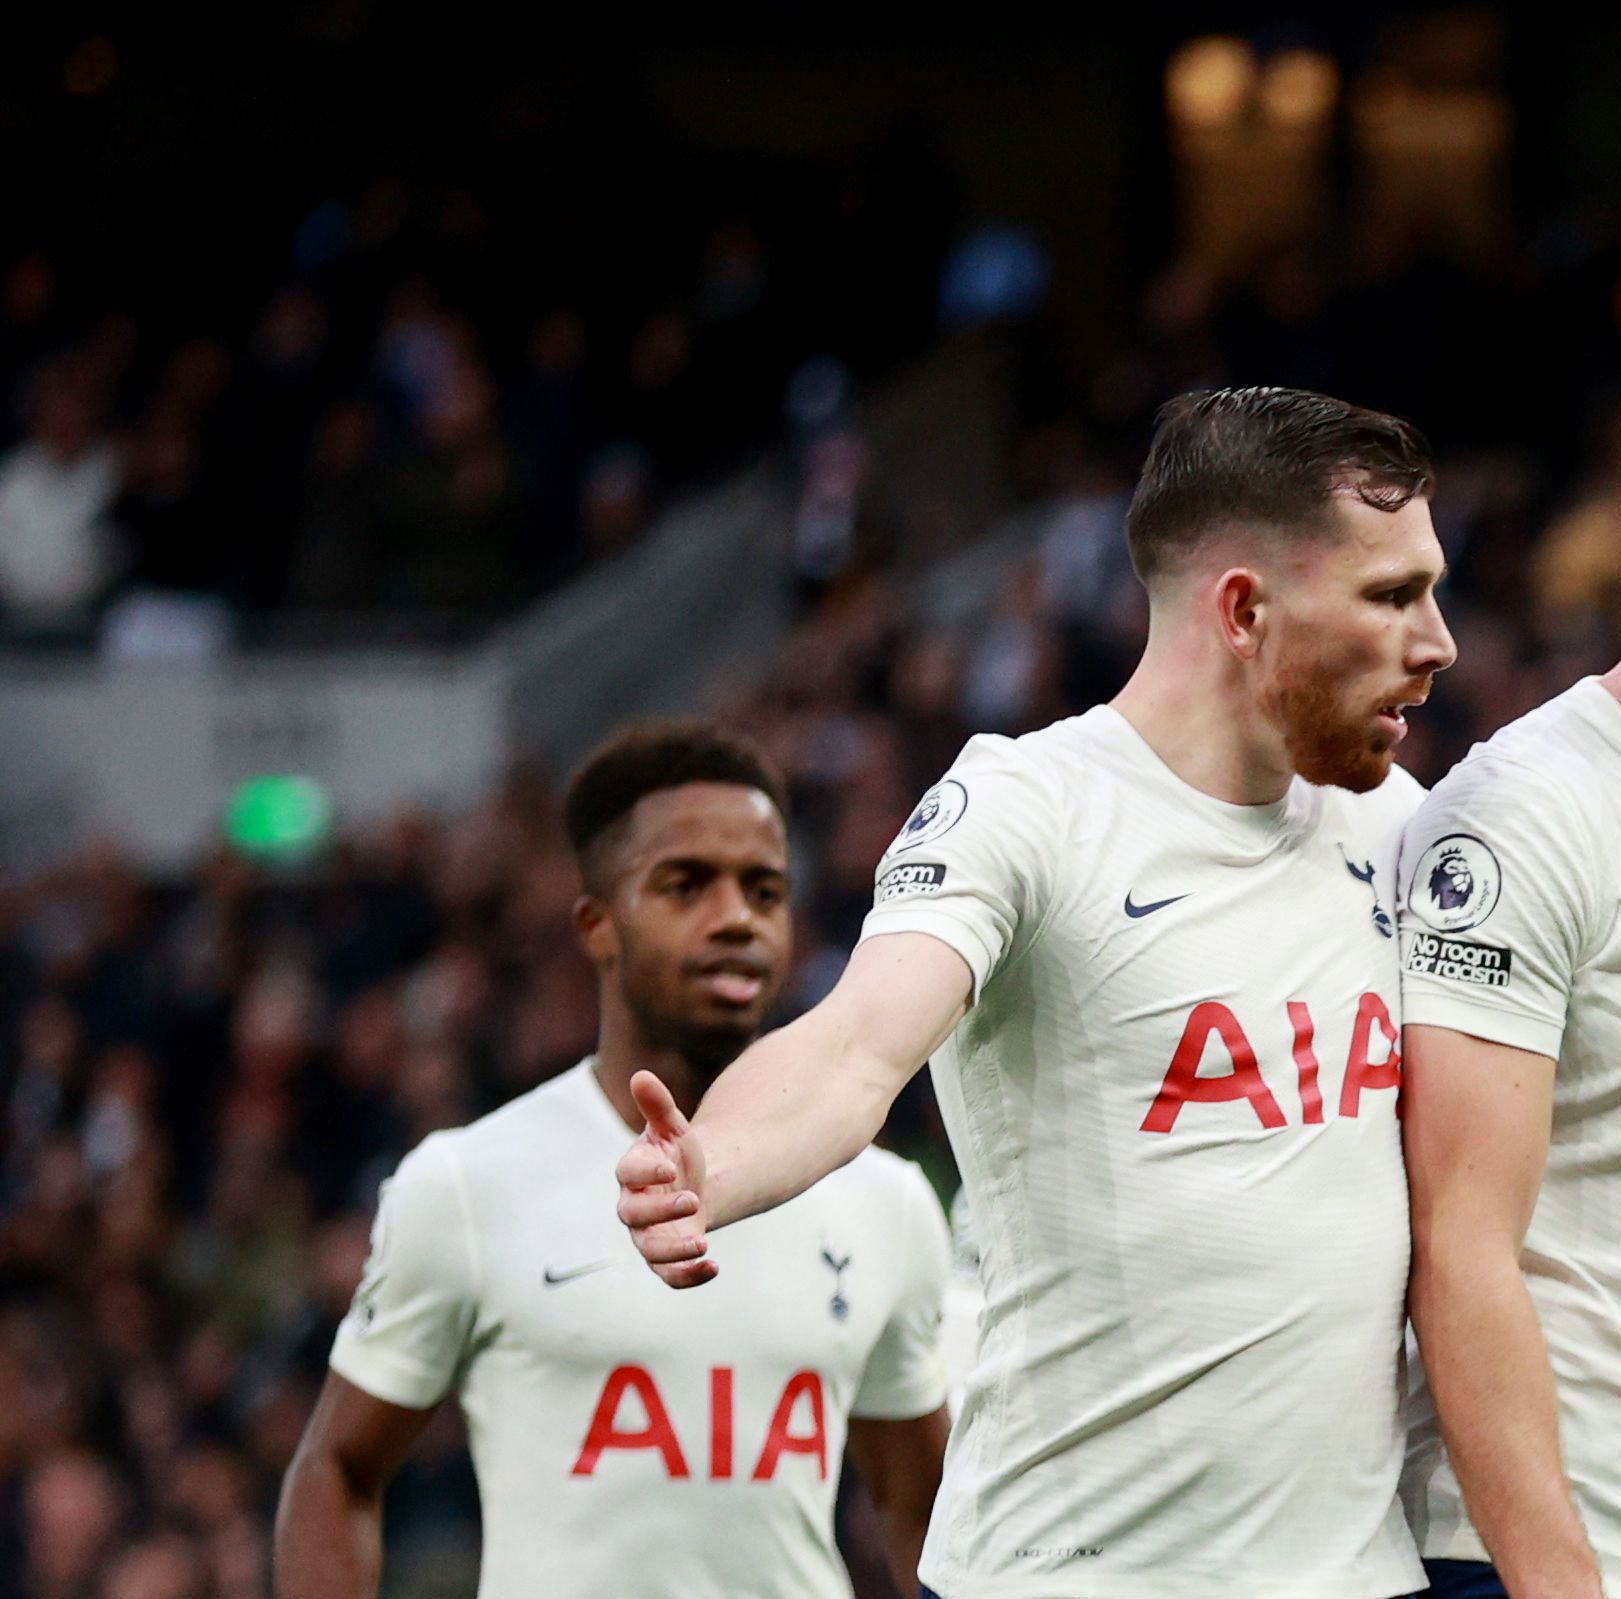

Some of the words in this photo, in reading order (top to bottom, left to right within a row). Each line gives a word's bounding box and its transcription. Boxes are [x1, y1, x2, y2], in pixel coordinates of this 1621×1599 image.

[1414, 934, 1440, 957] No
[1441, 943, 1501, 968] room
[1434, 959, 1510, 987] racism
[569, 1363, 828, 1481] AIA
